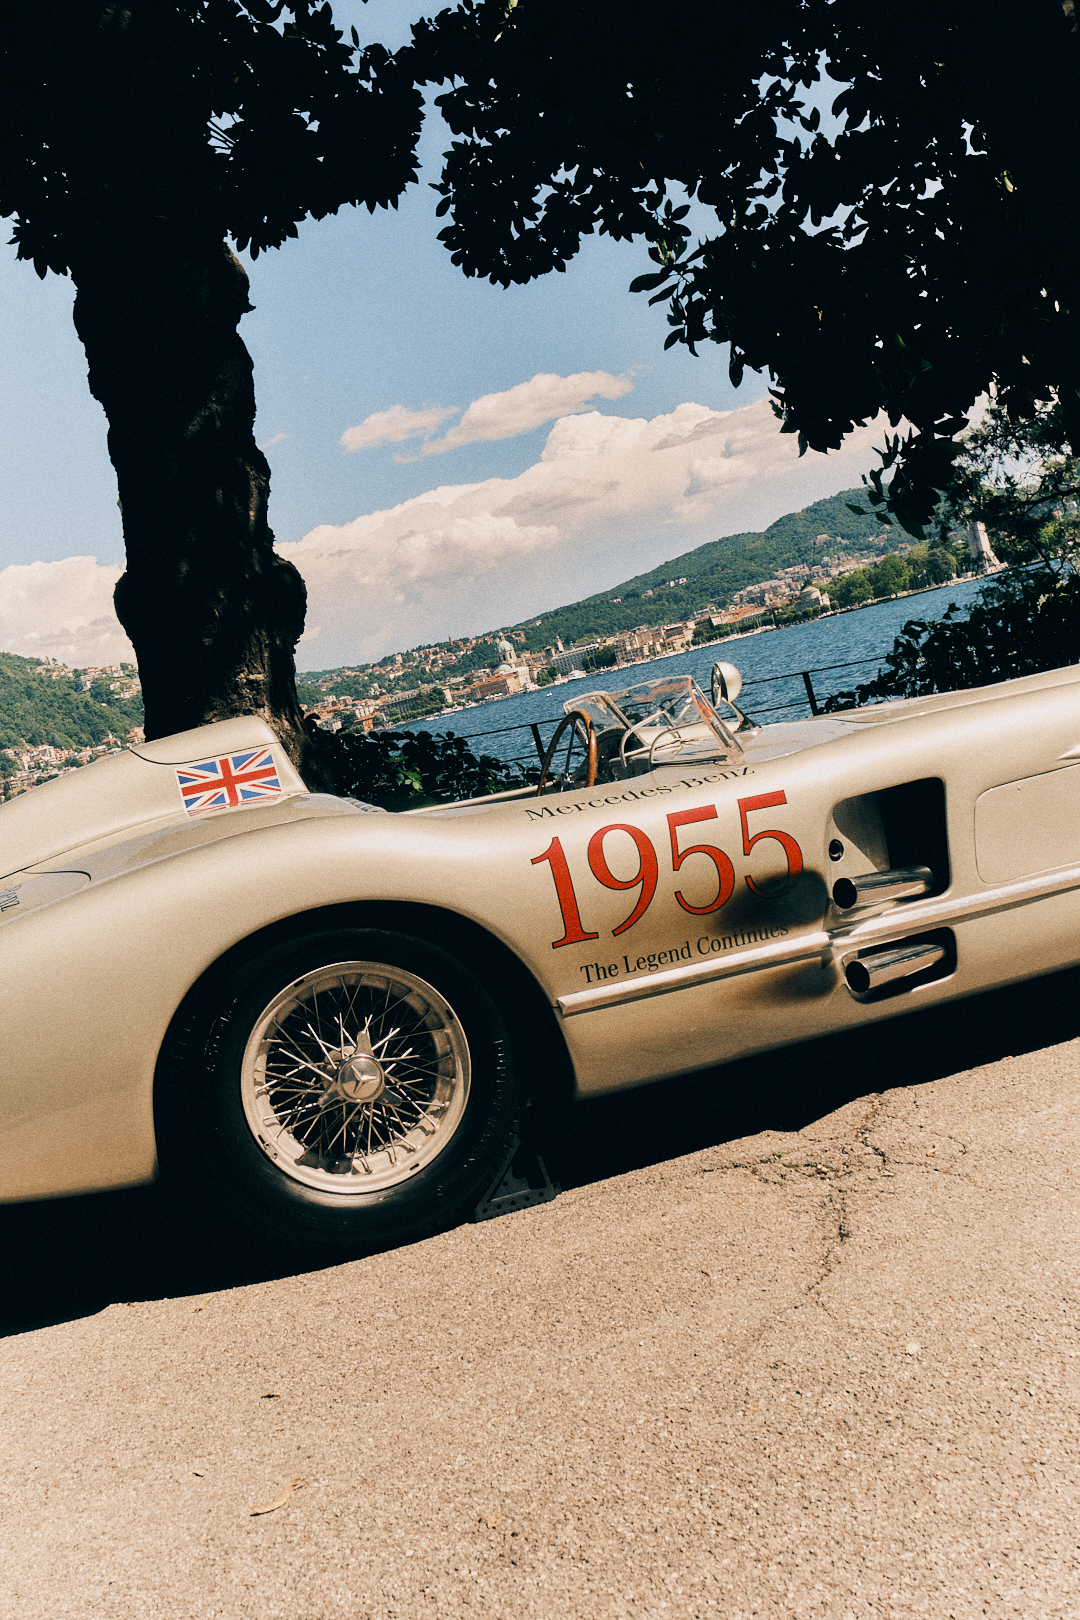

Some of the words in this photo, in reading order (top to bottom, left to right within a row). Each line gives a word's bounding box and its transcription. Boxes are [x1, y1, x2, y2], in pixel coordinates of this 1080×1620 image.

[524, 766, 755, 821] Mercedes-Benz
[530, 789, 804, 949] 1955
[580, 962, 619, 983] The
[623, 941, 693, 972] Legend
[696, 924, 789, 955] Continues
